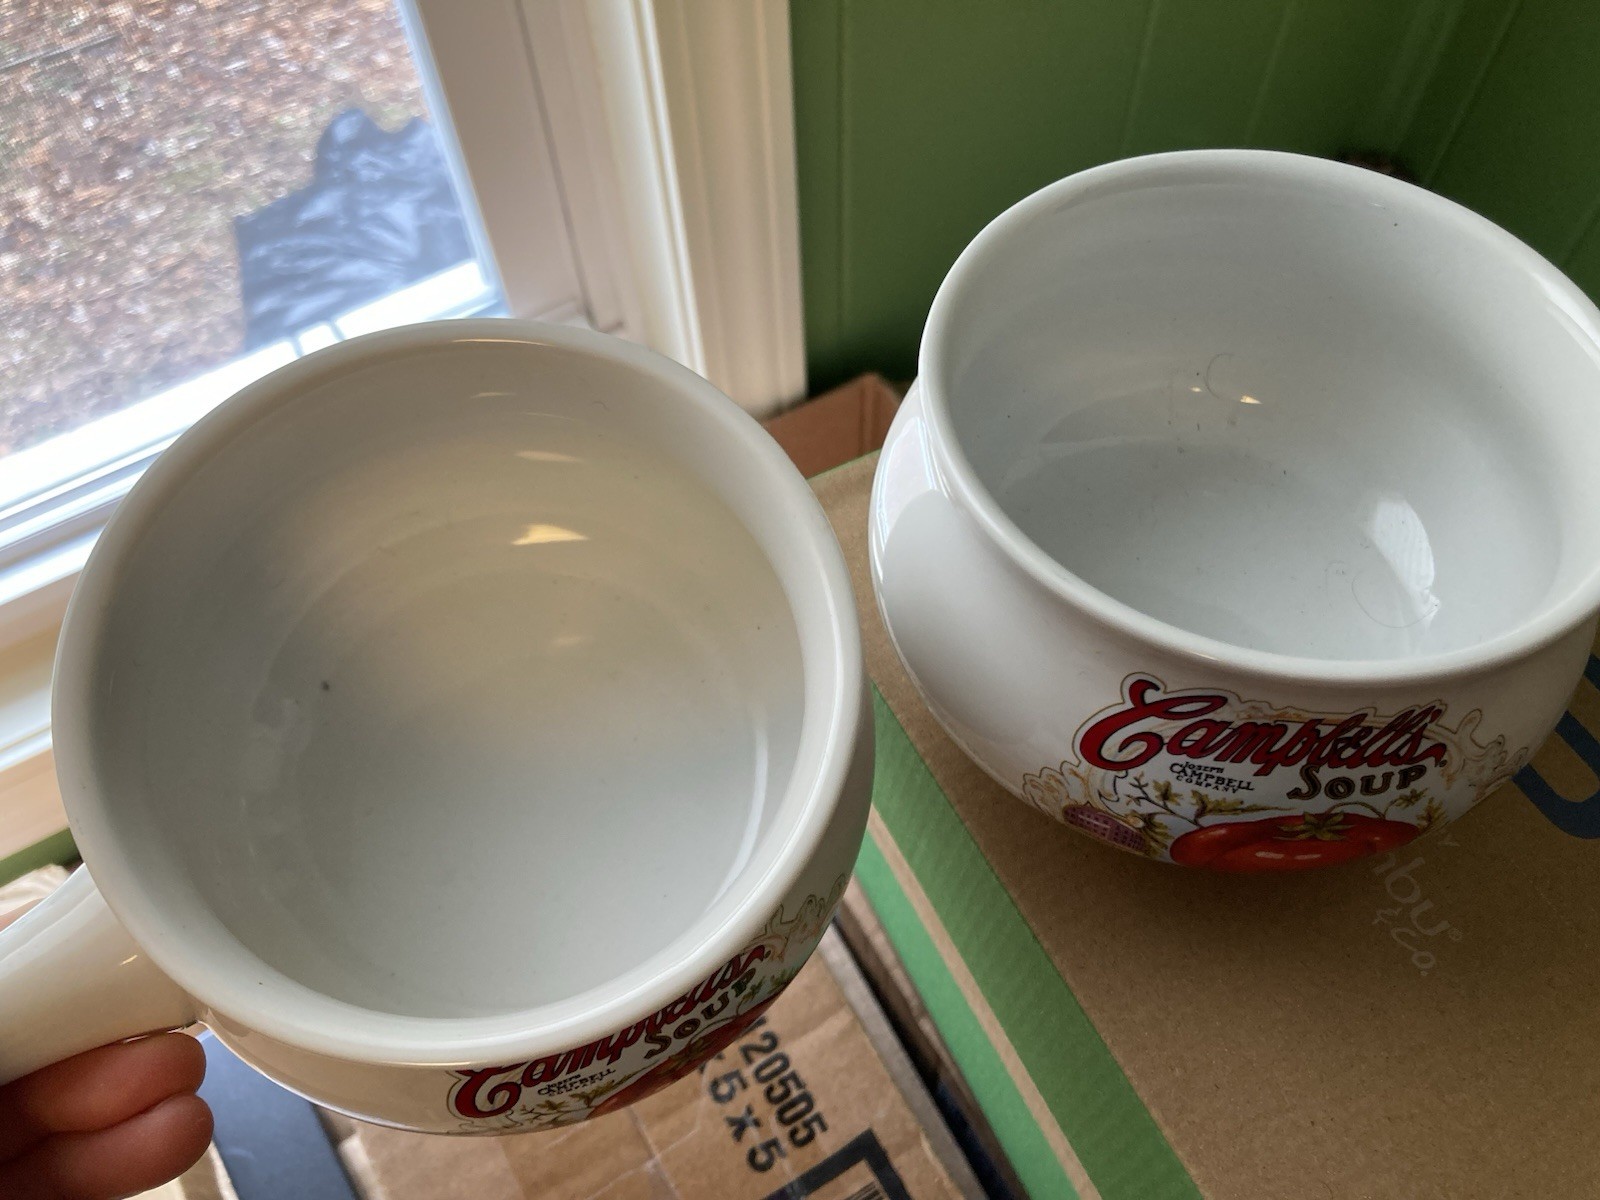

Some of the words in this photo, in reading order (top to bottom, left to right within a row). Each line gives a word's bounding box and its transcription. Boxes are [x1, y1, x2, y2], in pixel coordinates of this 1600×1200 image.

[1080, 677, 1446, 777] Campbell's
[1169, 763, 1256, 792] CAMPBELL
[1175, 775, 1239, 795] COMPANY
[1184, 761, 1225, 774] JOSEPH
[1286, 764, 1428, 799] SOUP
[644, 968, 757, 1059] SOUP
[709, 1068, 748, 1105] 5
[746, 1136, 787, 1174] 5
